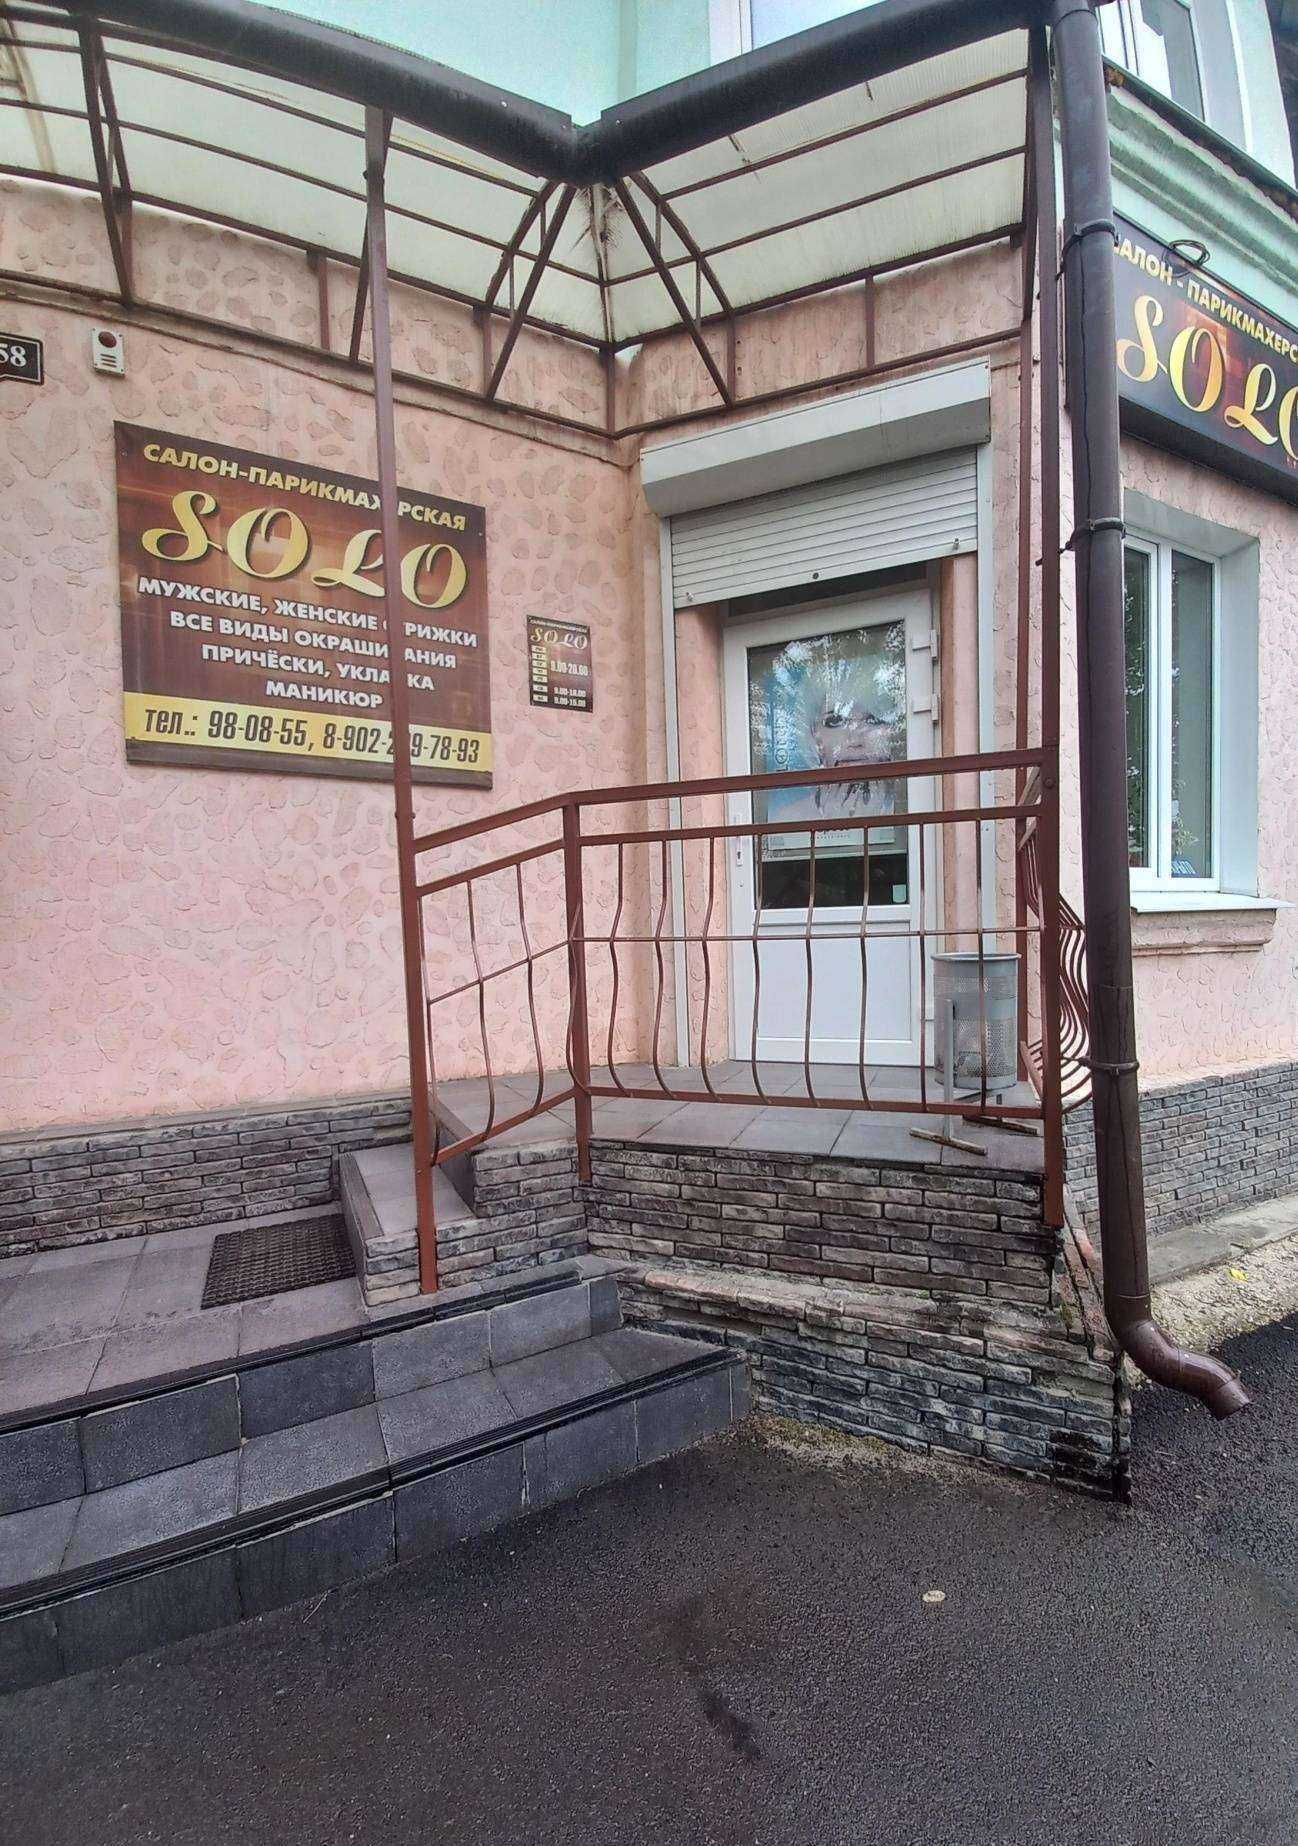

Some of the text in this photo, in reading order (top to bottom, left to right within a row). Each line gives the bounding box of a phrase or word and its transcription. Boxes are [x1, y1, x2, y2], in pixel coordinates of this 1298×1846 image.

[1114, 234, 1173, 286] АЛОН
[143, 443, 467, 530] САЛОН-ПАРИКМАХРСКАЯ
[141, 490, 468, 609] SOLO
[138, 577, 478, 648] МУЖСКИЕ, ЖЕНСКИЕ РИЖКИ
[170, 610, 457, 669] ВСЕ ВИДЫ ОКРАШИАНИЯ
[530, 628, 588, 650] SOLO
[202, 644, 435, 691] ПРИЧЁСКИ, УКЛАКА
[266, 679, 384, 709] МАНИКЮР
[145, 708, 480, 763] тел.: 98-08-55, 8-902-29-78-93
